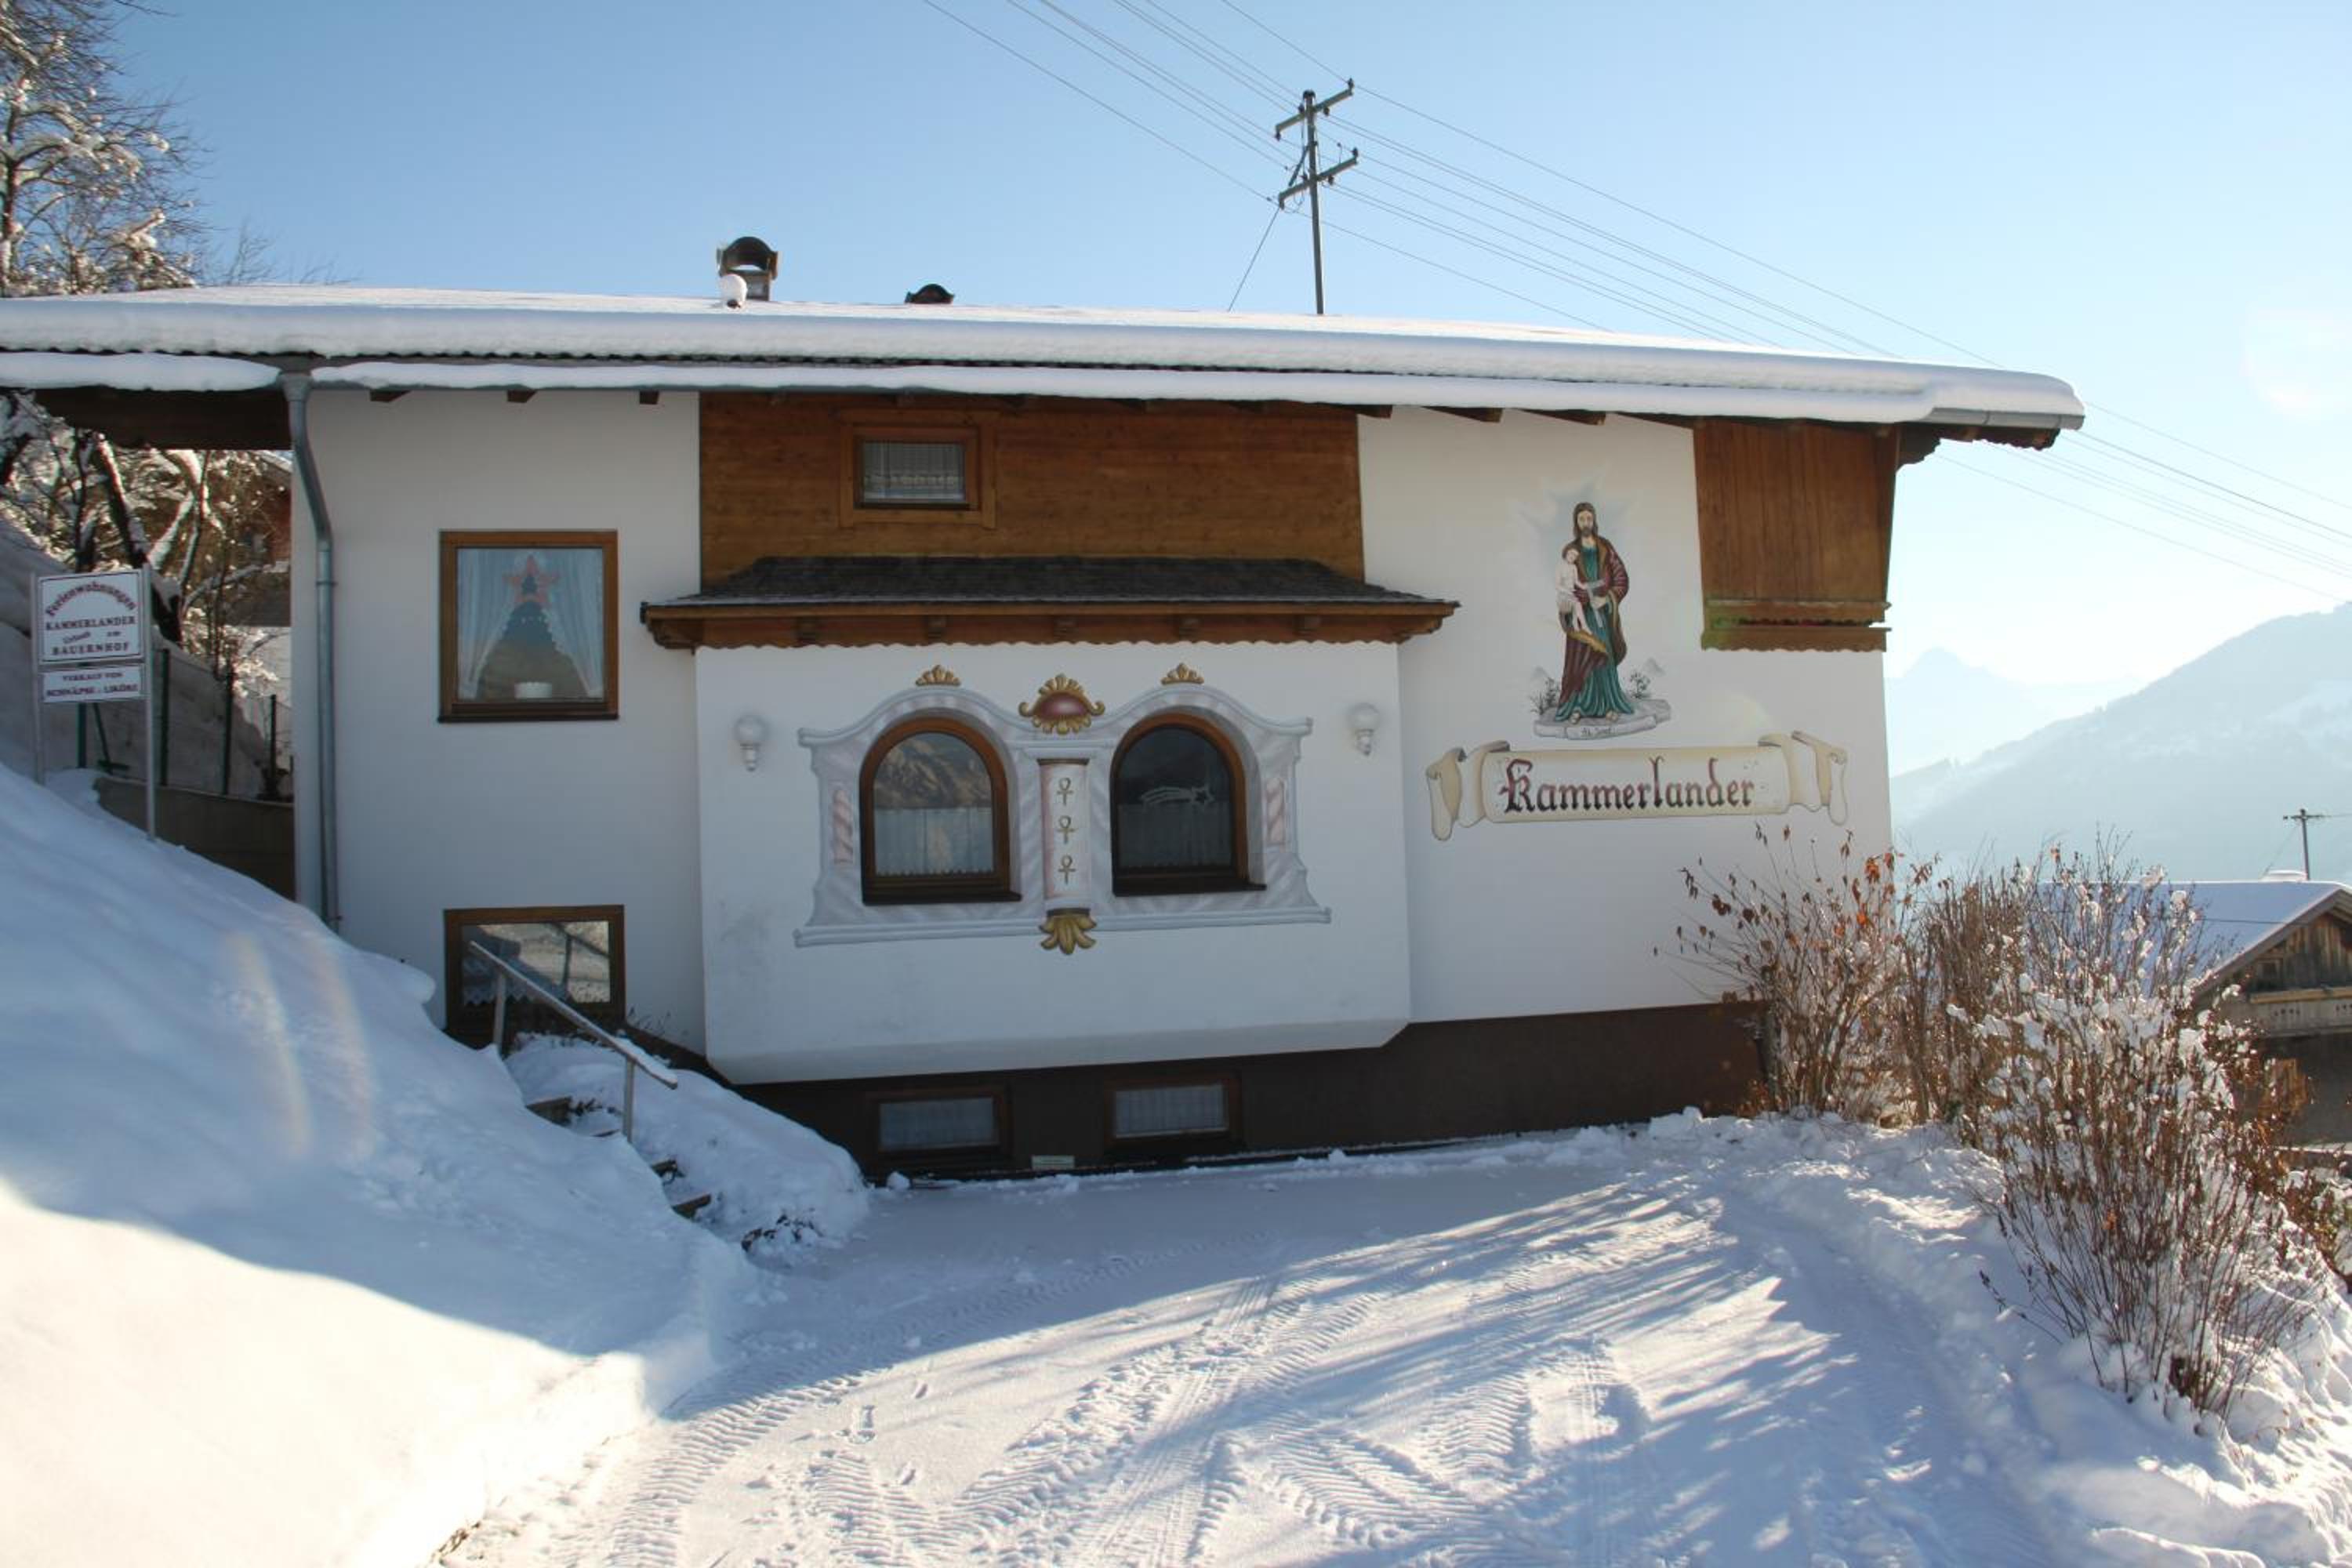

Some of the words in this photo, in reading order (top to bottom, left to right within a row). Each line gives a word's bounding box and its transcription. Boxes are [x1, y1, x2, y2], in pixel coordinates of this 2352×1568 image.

[46, 615, 135, 630] KAMMERLANDER
[53, 642, 128, 655] BAUERNHOF
[1500, 756, 1755, 813] Kammerlander
